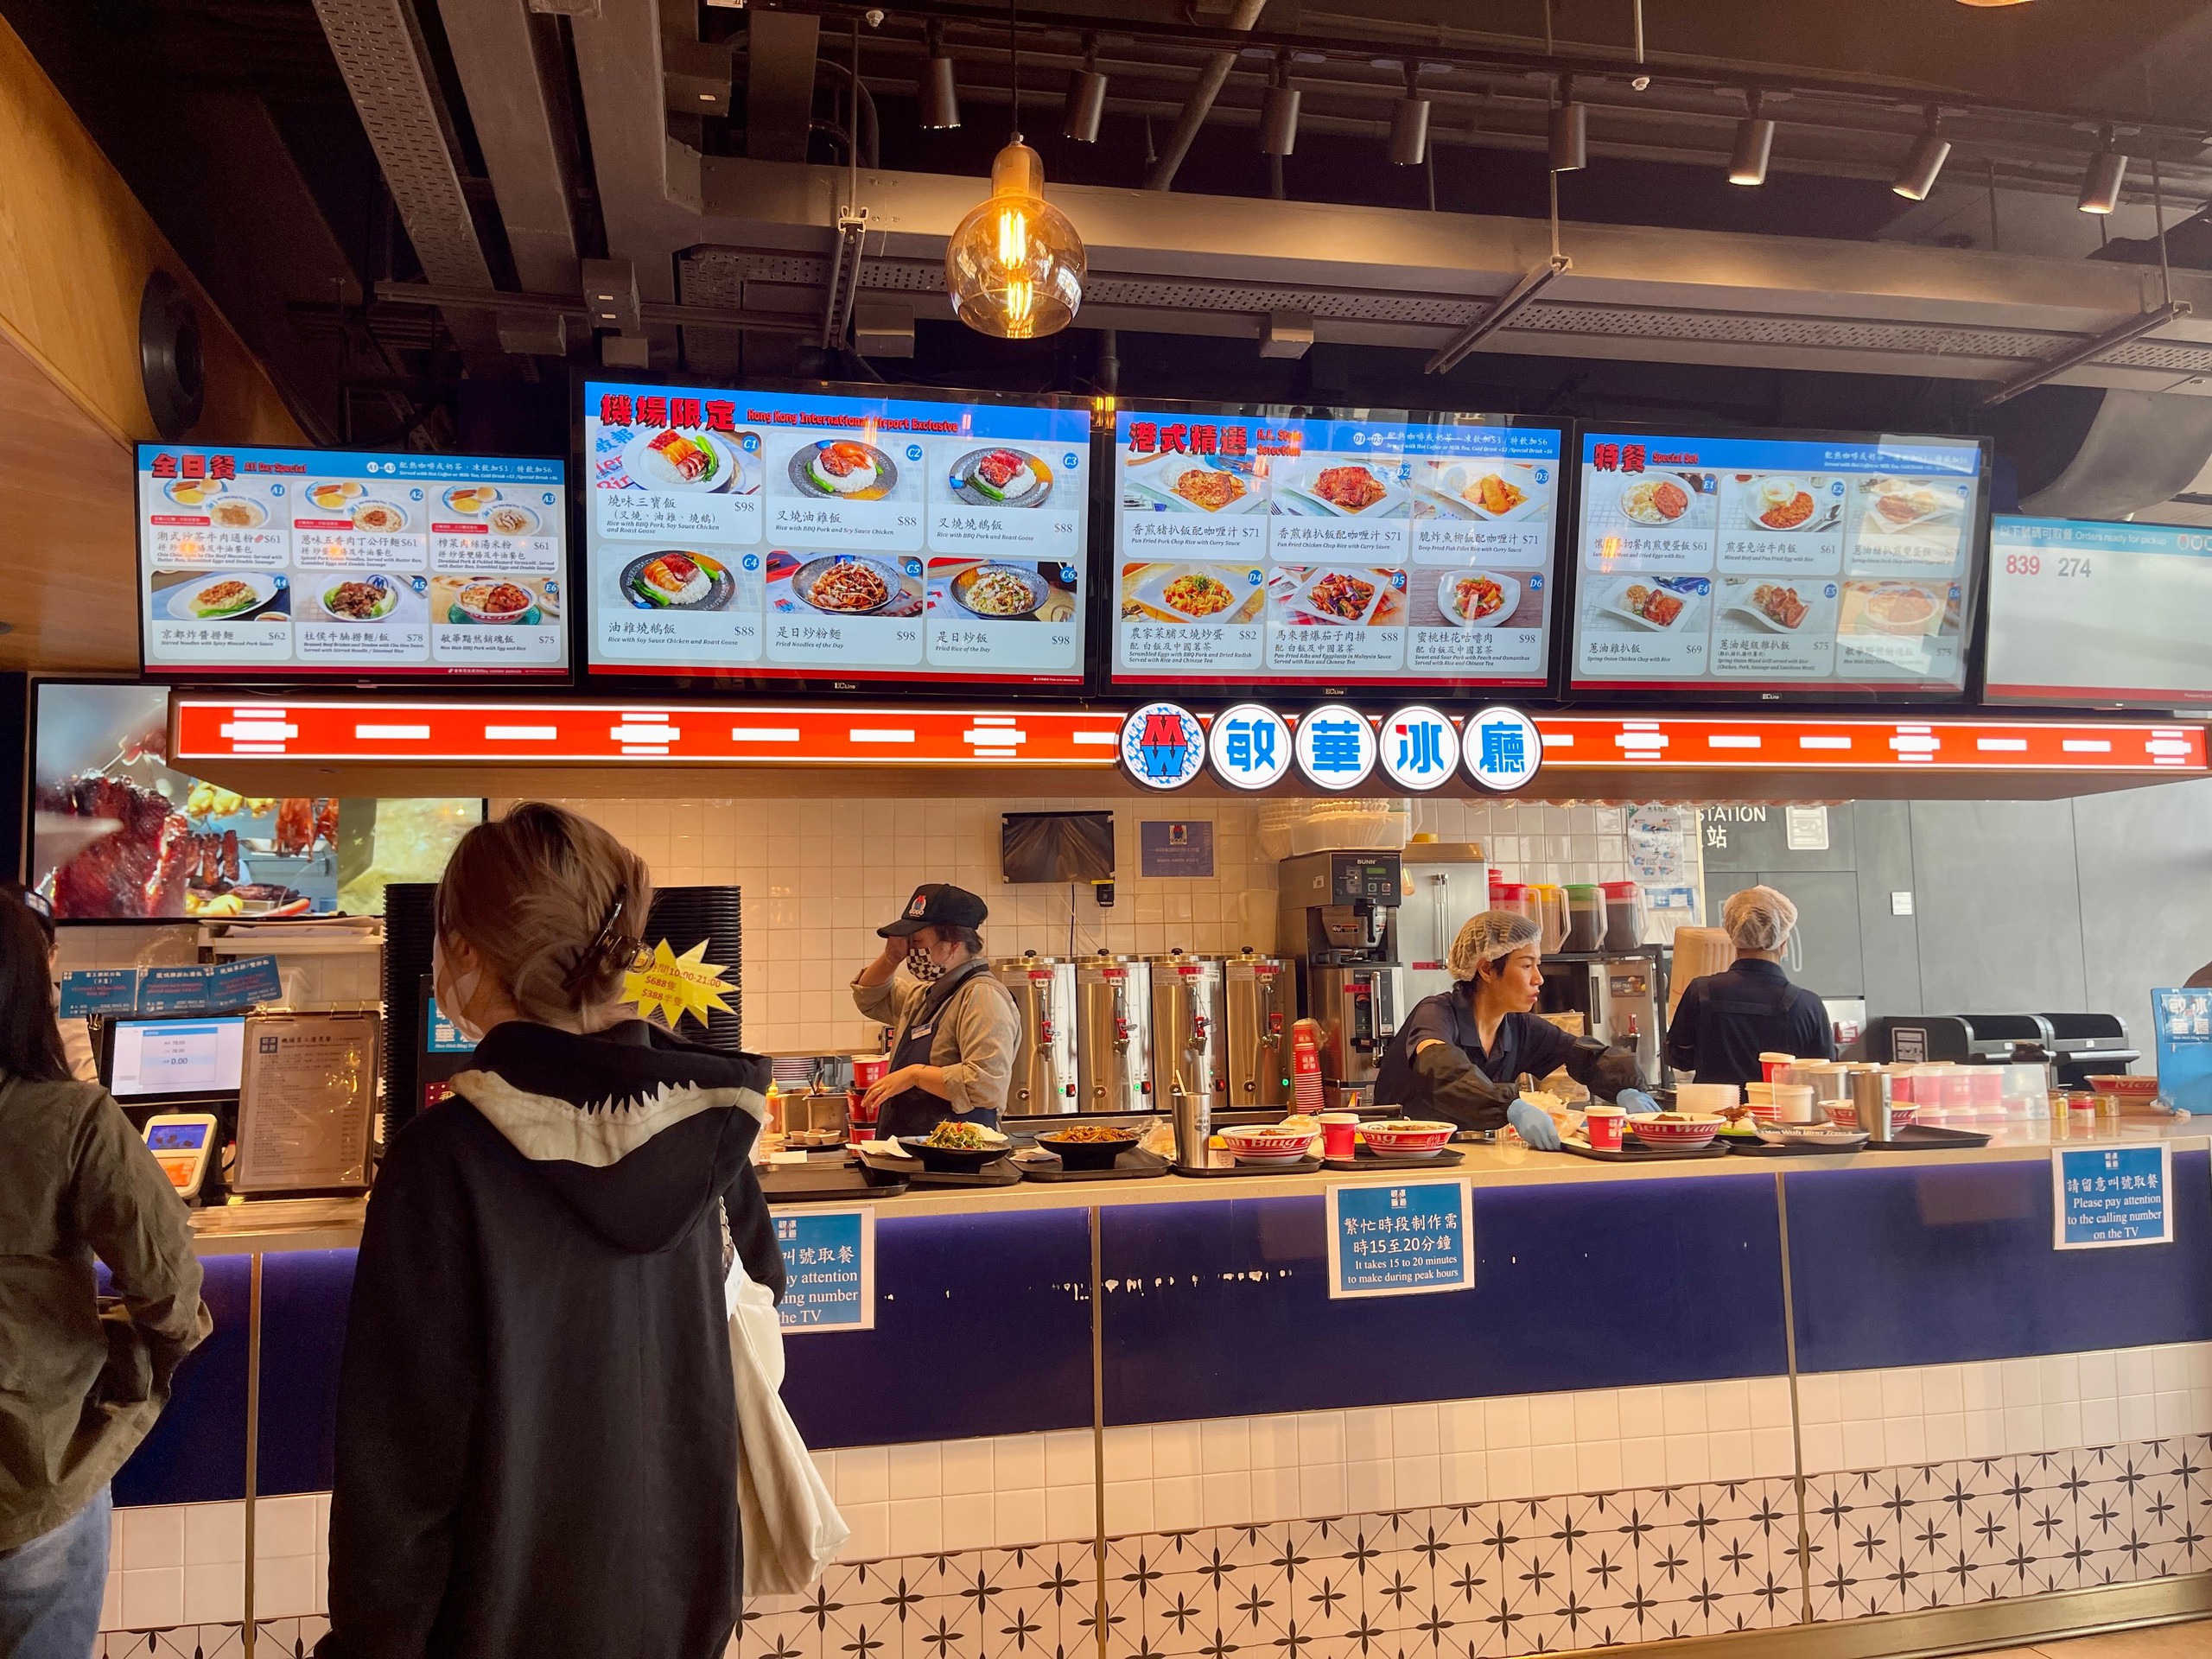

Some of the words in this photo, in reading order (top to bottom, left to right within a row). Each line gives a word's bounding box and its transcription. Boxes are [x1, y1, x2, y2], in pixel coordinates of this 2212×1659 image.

[601, 394, 735, 432] 機場限定
[747, 410, 772, 423] Hong
[773, 411, 798, 425] Kong
[800, 412, 869, 429] International
[912, 419, 958, 432] Exclusive
[1128, 423, 1247, 454] 港式精選
[1257, 430, 1274, 440] H.K.
[743, 439, 757, 448] C1
[908, 448, 920, 457] C2
[1594, 443, 1646, 473] 特餐
[1653, 452, 1682, 464] Special
[1685, 454, 1698, 464] Set
[1064, 456, 1077, 465] C3
[151, 454, 236, 480] 全日餐
[245, 462, 256, 472] All
[259, 463, 272, 473] Day
[274, 462, 307, 474] Special
[607, 495, 677, 509] 燒味三寶飯
[734, 502, 754, 512] $98
[778, 511, 842, 524] 叉燒油雞飯
[898, 517, 917, 526] $88
[1054, 524, 1072, 533] $88
[1243, 528, 1259, 537] $71
[1385, 532, 1401, 541] $71
[1522, 536, 1538, 544] $71
[2075, 531, 2102, 542] Orders
[2105, 534, 2126, 544] ready
[2128, 534, 2139, 543] for
[2141, 535, 2166, 545] pickup
[744, 558, 758, 567] C4
[907, 564, 920, 573] C5
[2006, 555, 2040, 575] 839
[2058, 557, 2091, 578] 274
[1062, 570, 1074, 579] C6
[1530, 579, 1542, 588] D6
[734, 626, 754, 636] $88
[777, 626, 841, 639] 是日炒粉麵
[897, 631, 915, 641] $98
[1382, 632, 1398, 641] $88
[937, 631, 988, 644] 是日炒飯
[1052, 635, 1070, 645] $98
[1519, 634, 1535, 644] $98
[1686, 645, 1701, 654] $69
[2067, 1173, 2158, 1193] 請留意叫號取餐
[2073, 1197, 2102, 1209] Please
[2105, 1197, 2120, 1209] pay
[2124, 1194, 2161, 1206] attention
[2068, 1217, 2077, 1225] to
[2080, 1214, 2094, 1224] the
[2096, 1211, 2127, 1225] calling
[2130, 1210, 2162, 1222] number
[1344, 1213, 1458, 1235] 繁忙時段制作需
[2094, 1230, 2105, 1239] on
[2108, 1229, 2122, 1238] the
[2125, 1227, 2139, 1237] TV
[1353, 1236, 1452, 1256] 時15至20分鐘
[1356, 1261, 1363, 1269] It
[1364, 1260, 1386, 1269] takes
[1390, 1259, 1400, 1268] 15
[1402, 1259, 1410, 1268] to
[1413, 1258, 1423, 1267] 20
[1426, 1255, 1457, 1266] minutes
[802, 1269, 857, 1283] attention
[1348, 1275, 1357, 1284] to
[1359, 1274, 1382, 1283] make
[1385, 1272, 1413, 1282] during
[1414, 1272, 1433, 1282] peak
[1436, 1269, 1459, 1279] hours
[809, 1289, 858, 1303] number
[800, 1310, 822, 1323] TV
